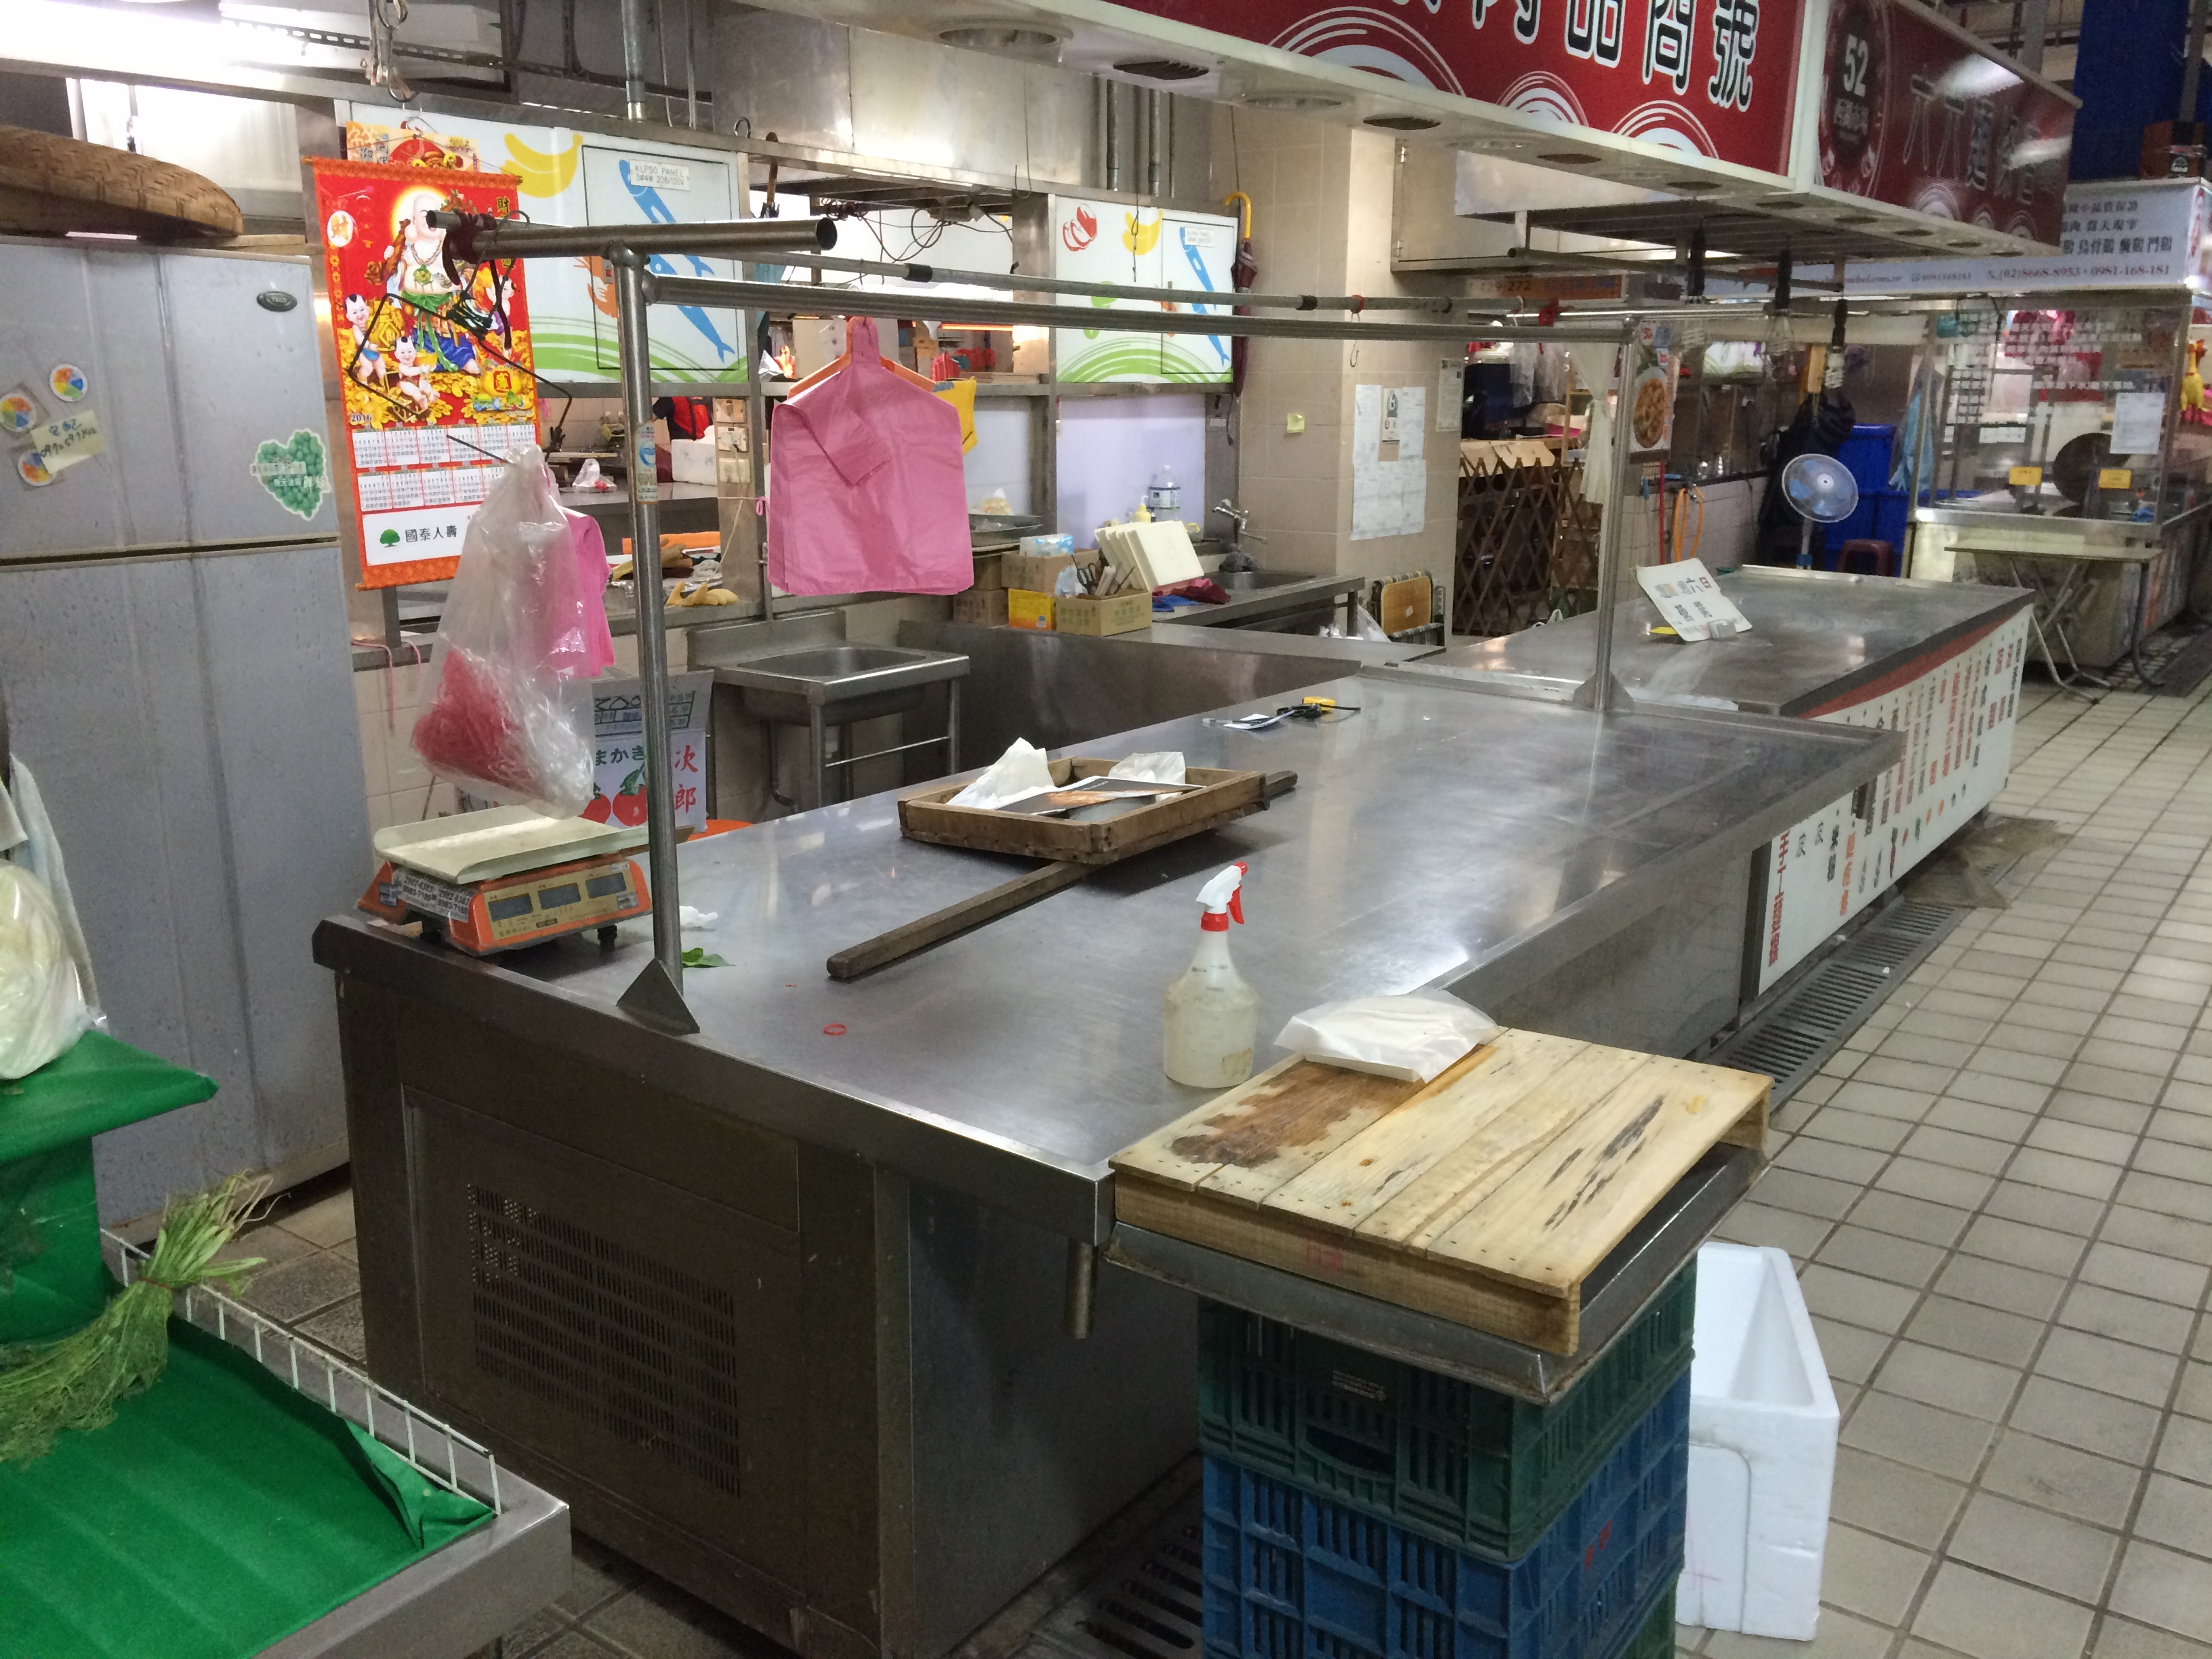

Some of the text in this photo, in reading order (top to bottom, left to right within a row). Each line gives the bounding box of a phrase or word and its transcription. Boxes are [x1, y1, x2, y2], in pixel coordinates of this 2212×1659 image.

[1843, 34, 1869, 97] 52
[634, 164, 684, 178] KLP50 PANEL
[350, 413, 372, 422] 2016
[405, 525, 457, 543] 國泰人壽
[673, 744, 699, 814] 次郎
